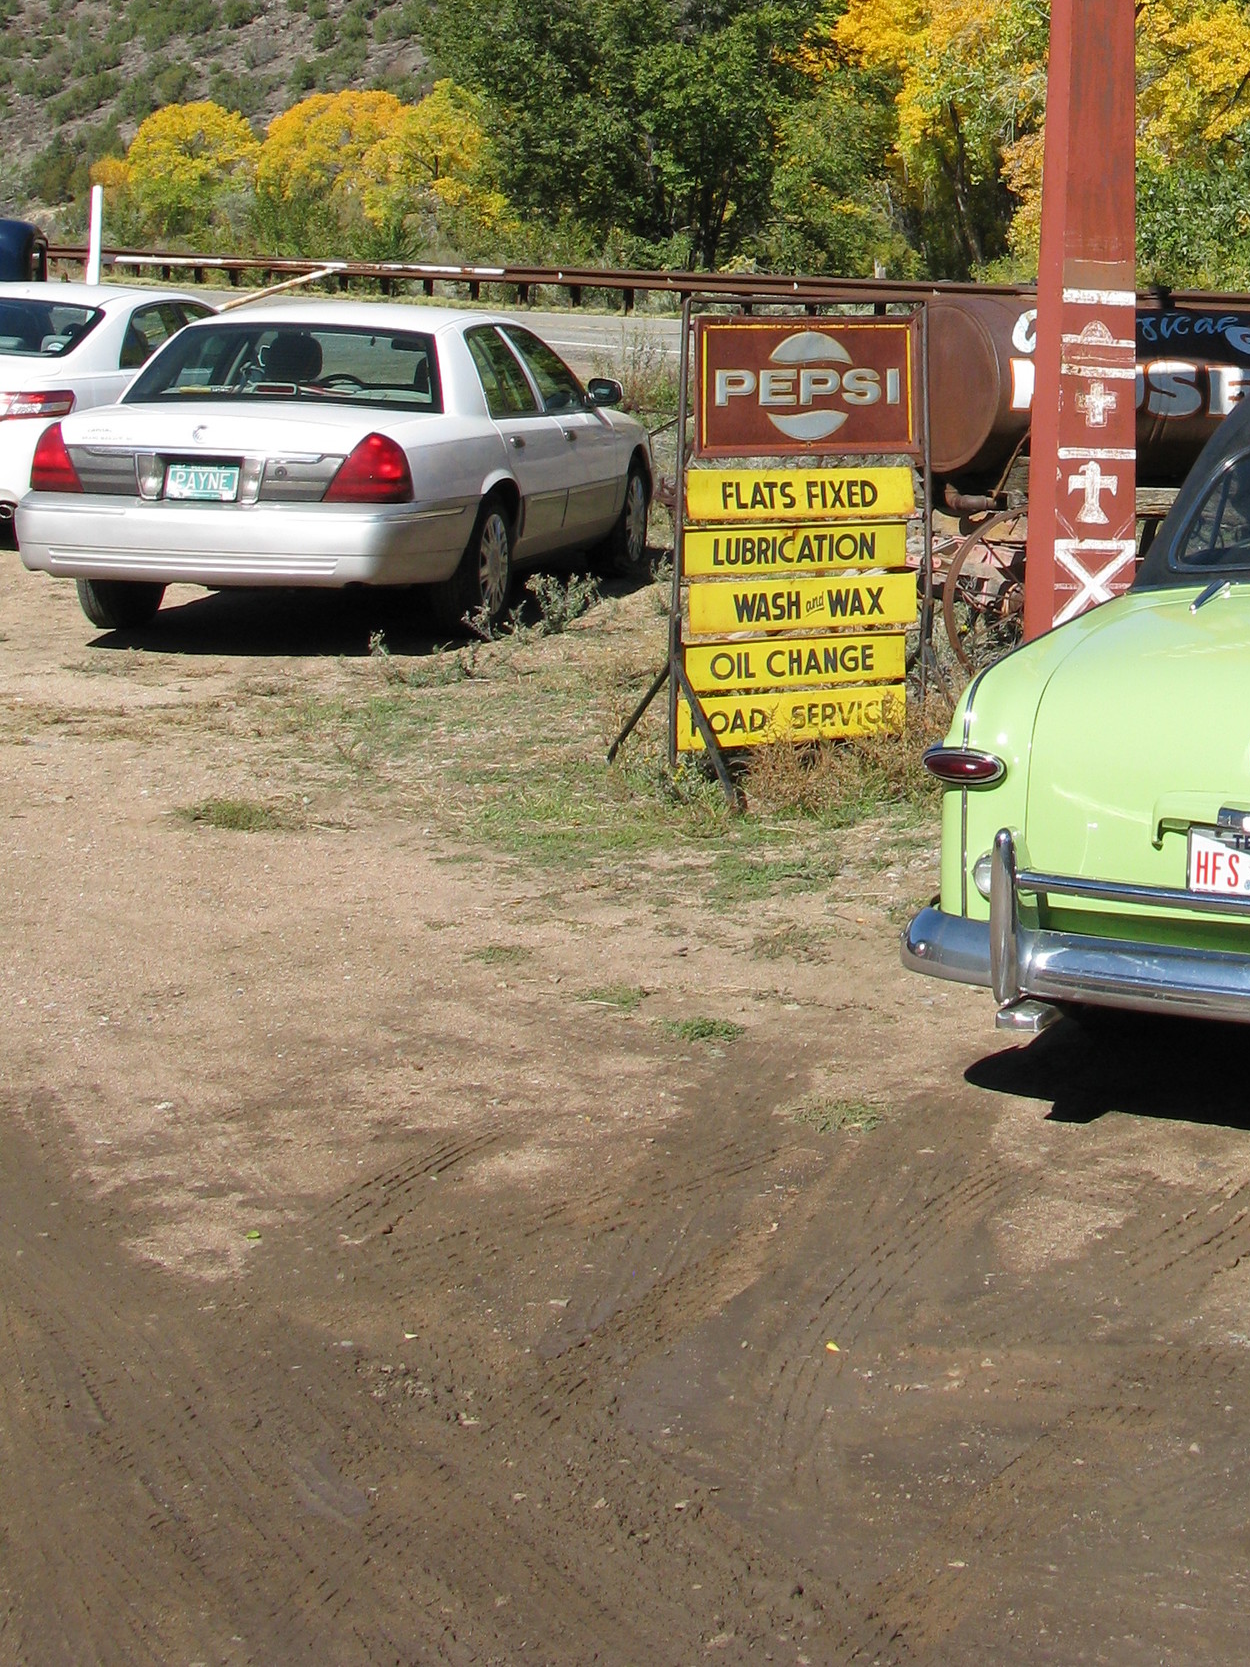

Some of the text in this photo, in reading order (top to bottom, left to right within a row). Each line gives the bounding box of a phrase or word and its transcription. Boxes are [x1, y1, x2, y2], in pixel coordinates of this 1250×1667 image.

[714, 367, 900, 407] PEPSI
[175, 471, 230, 490] PAYNE
[722, 479, 878, 510] FLATS FIXED
[713, 531, 876, 566] LUBRICATION
[733, 587, 885, 623] WASH and WAX
[710, 644, 874, 679] OIL CHANGE
[1196, 851, 1240, 887] HFS
